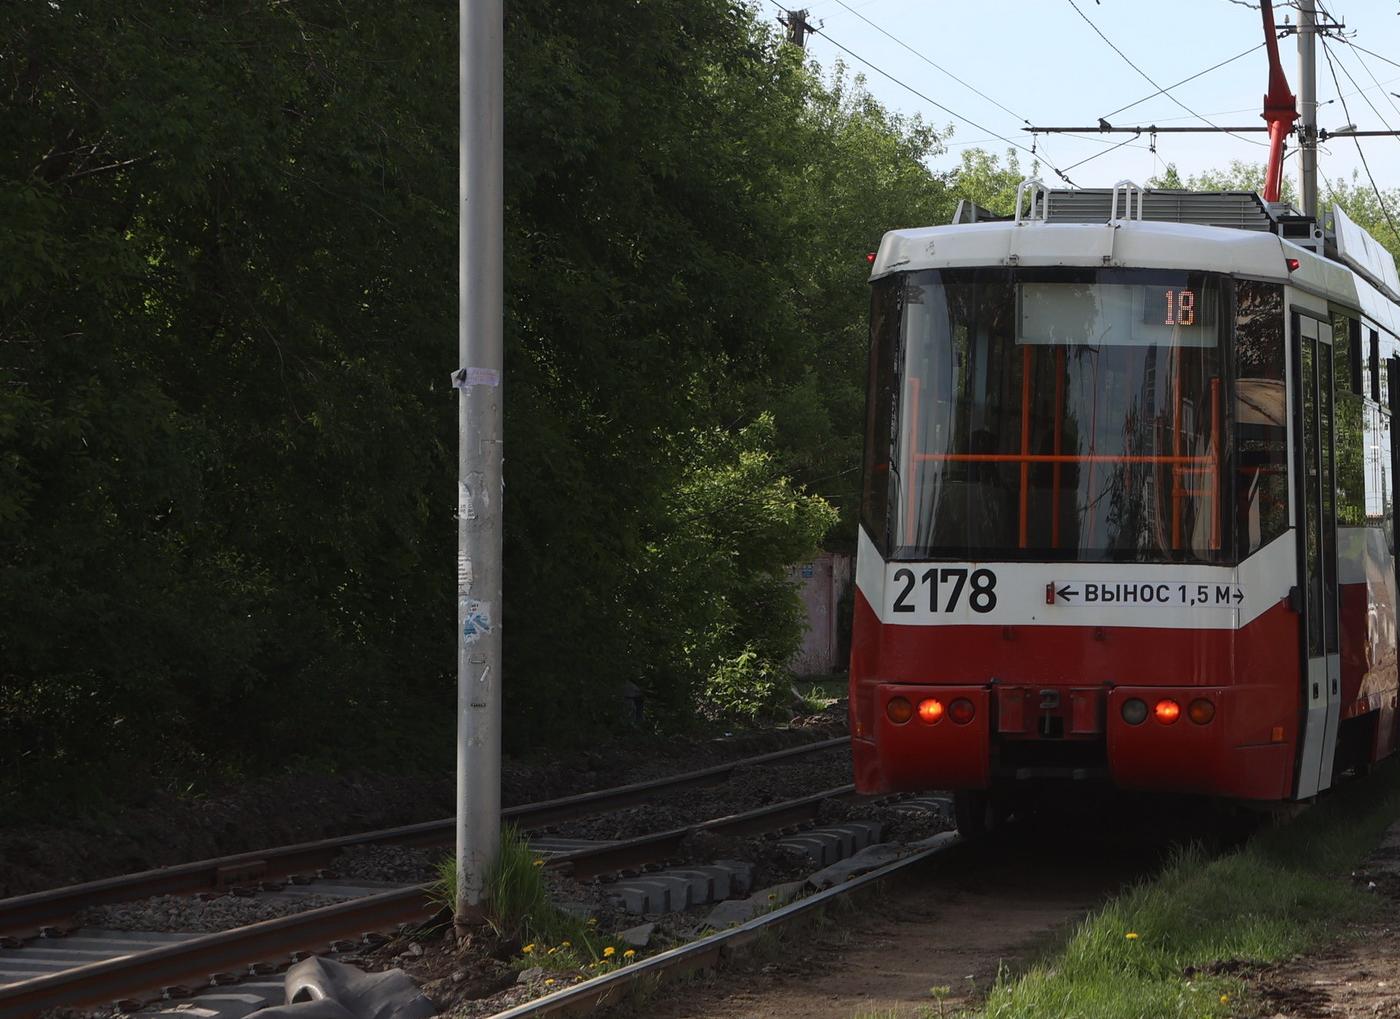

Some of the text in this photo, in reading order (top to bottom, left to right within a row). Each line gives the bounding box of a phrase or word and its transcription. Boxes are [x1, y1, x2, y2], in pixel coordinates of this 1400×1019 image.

[1165, 290, 1194, 325] 18
[892, 568, 998, 613] 2178
[1085, 584, 1232, 607] ВЫНОС 1,5 М
